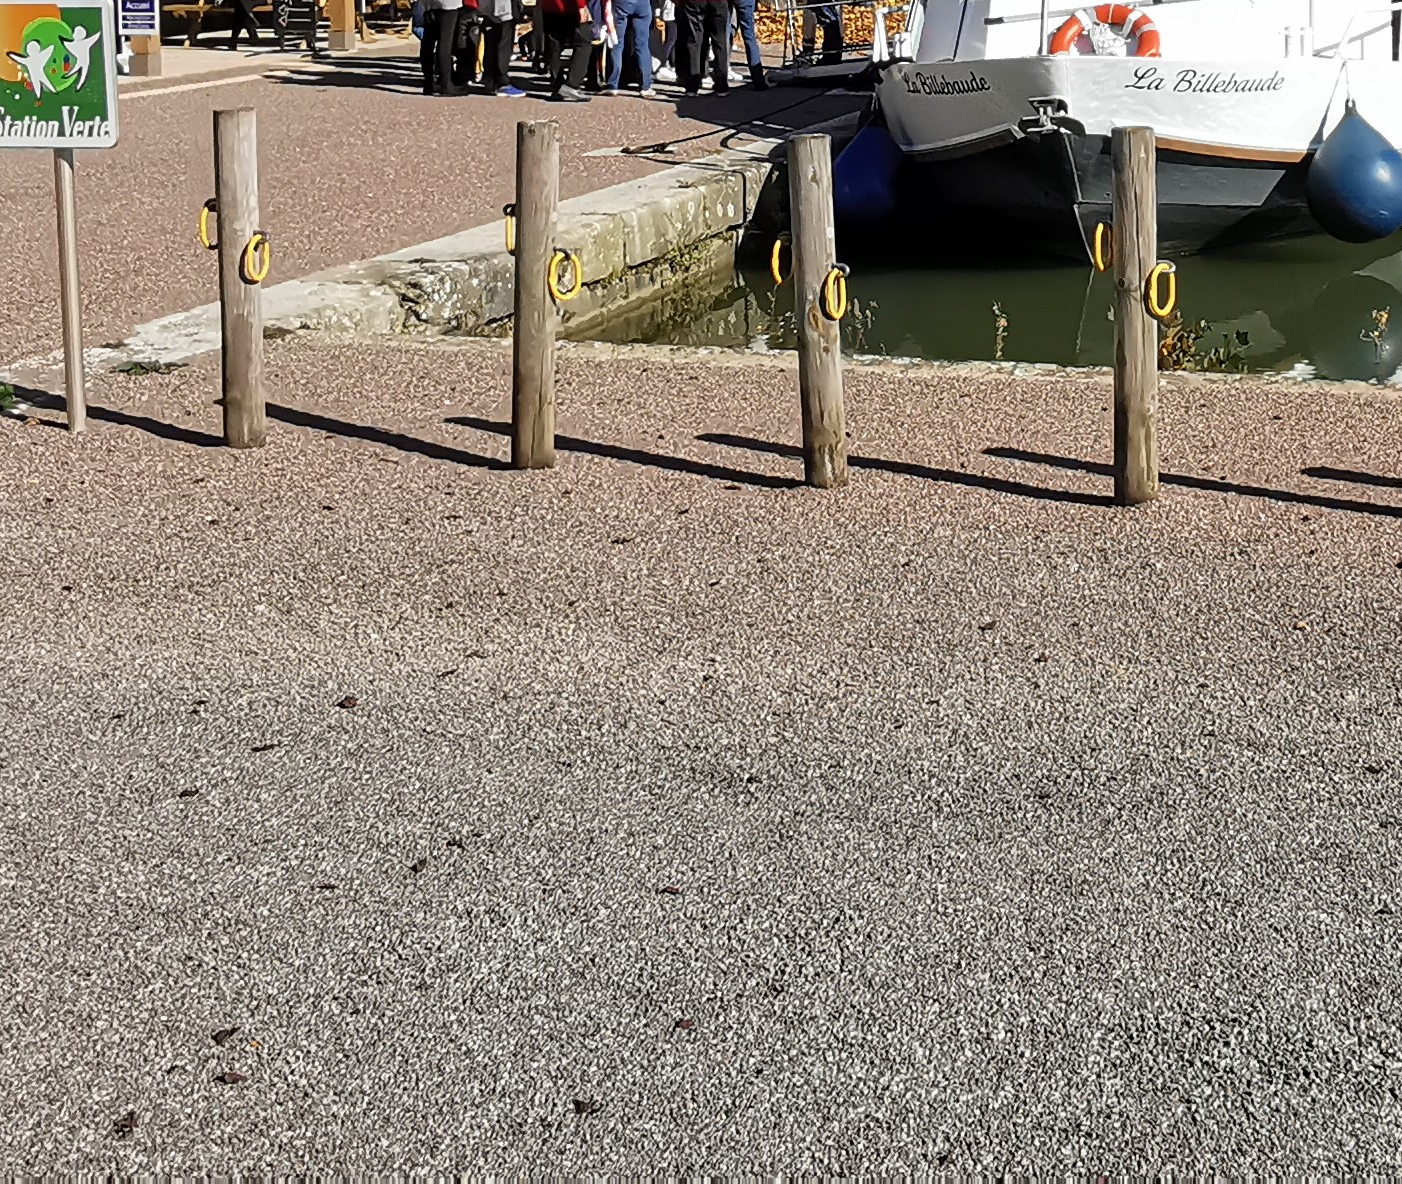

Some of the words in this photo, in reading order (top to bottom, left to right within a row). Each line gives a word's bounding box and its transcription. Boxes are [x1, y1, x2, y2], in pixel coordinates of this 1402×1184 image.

[901, 71, 921, 94] La
[915, 71, 990, 95] Billebaude
[1124, 67, 1165, 91] La
[1173, 69, 1285, 93] Billebaude
[62, 106, 111, 137] Verte
